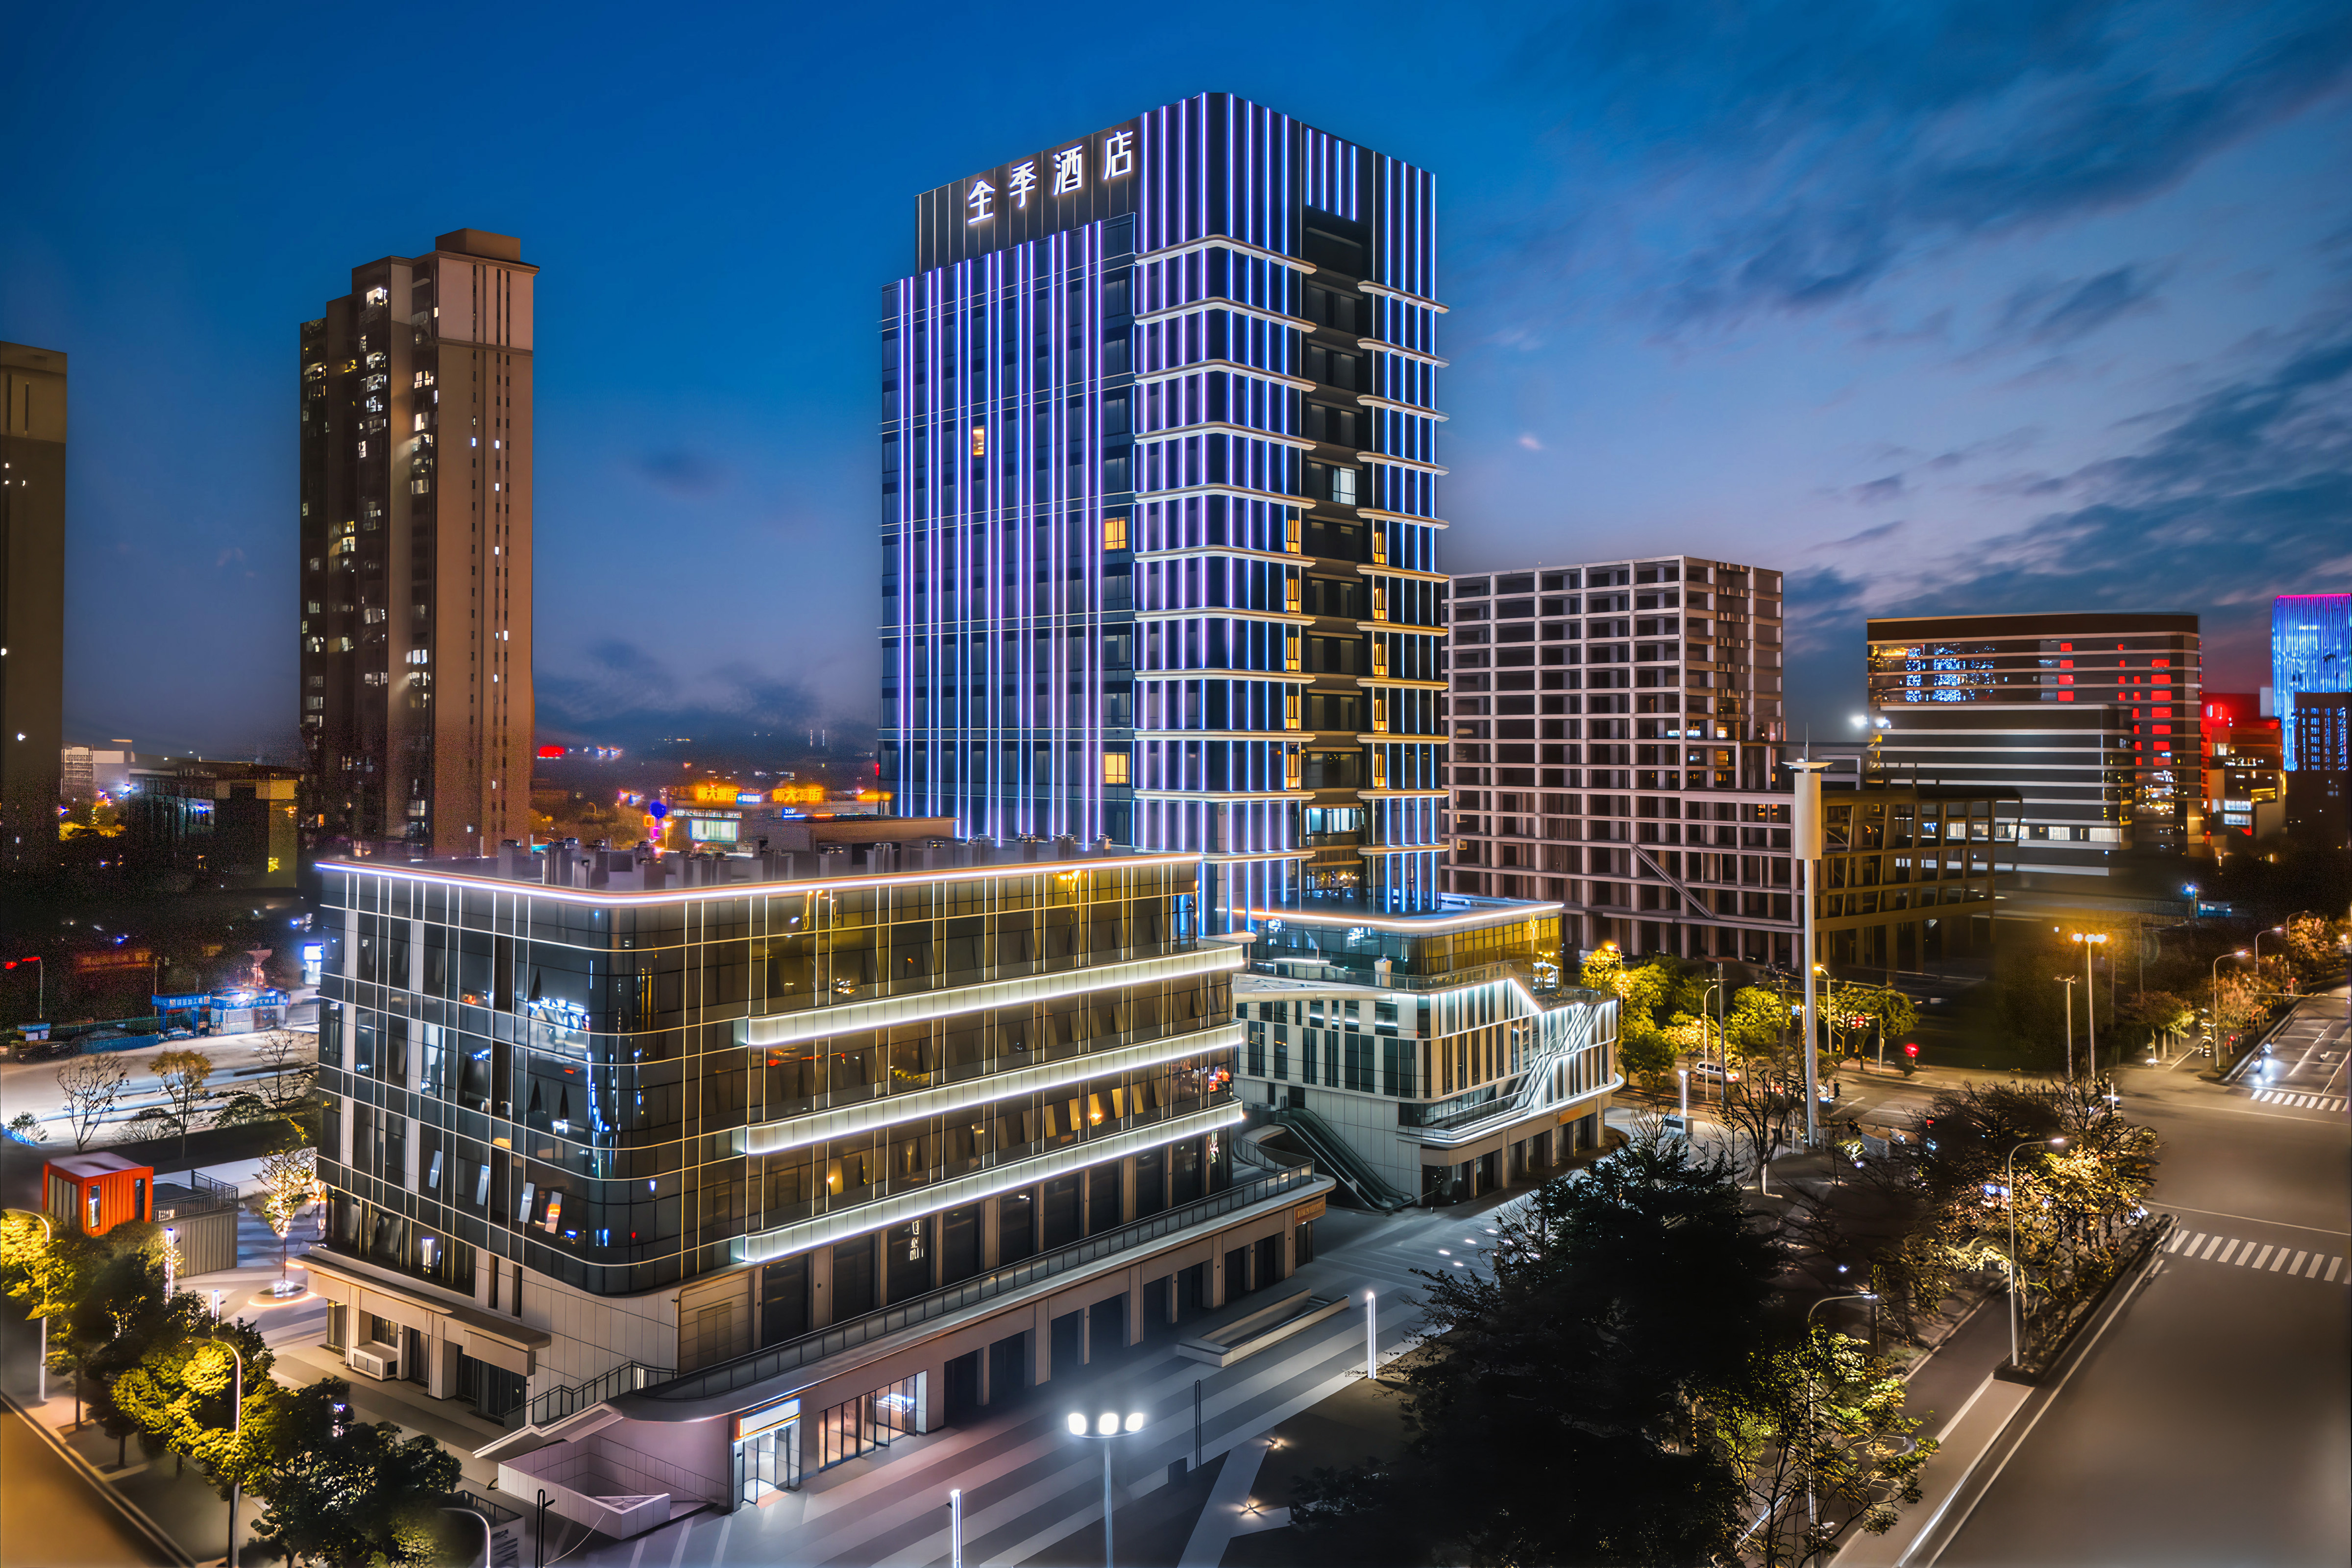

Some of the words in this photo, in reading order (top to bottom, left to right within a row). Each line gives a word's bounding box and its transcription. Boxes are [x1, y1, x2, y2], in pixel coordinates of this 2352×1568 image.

[968, 130, 1133, 223] 全季酒店
[773, 788, 822, 802] 师大潮街
